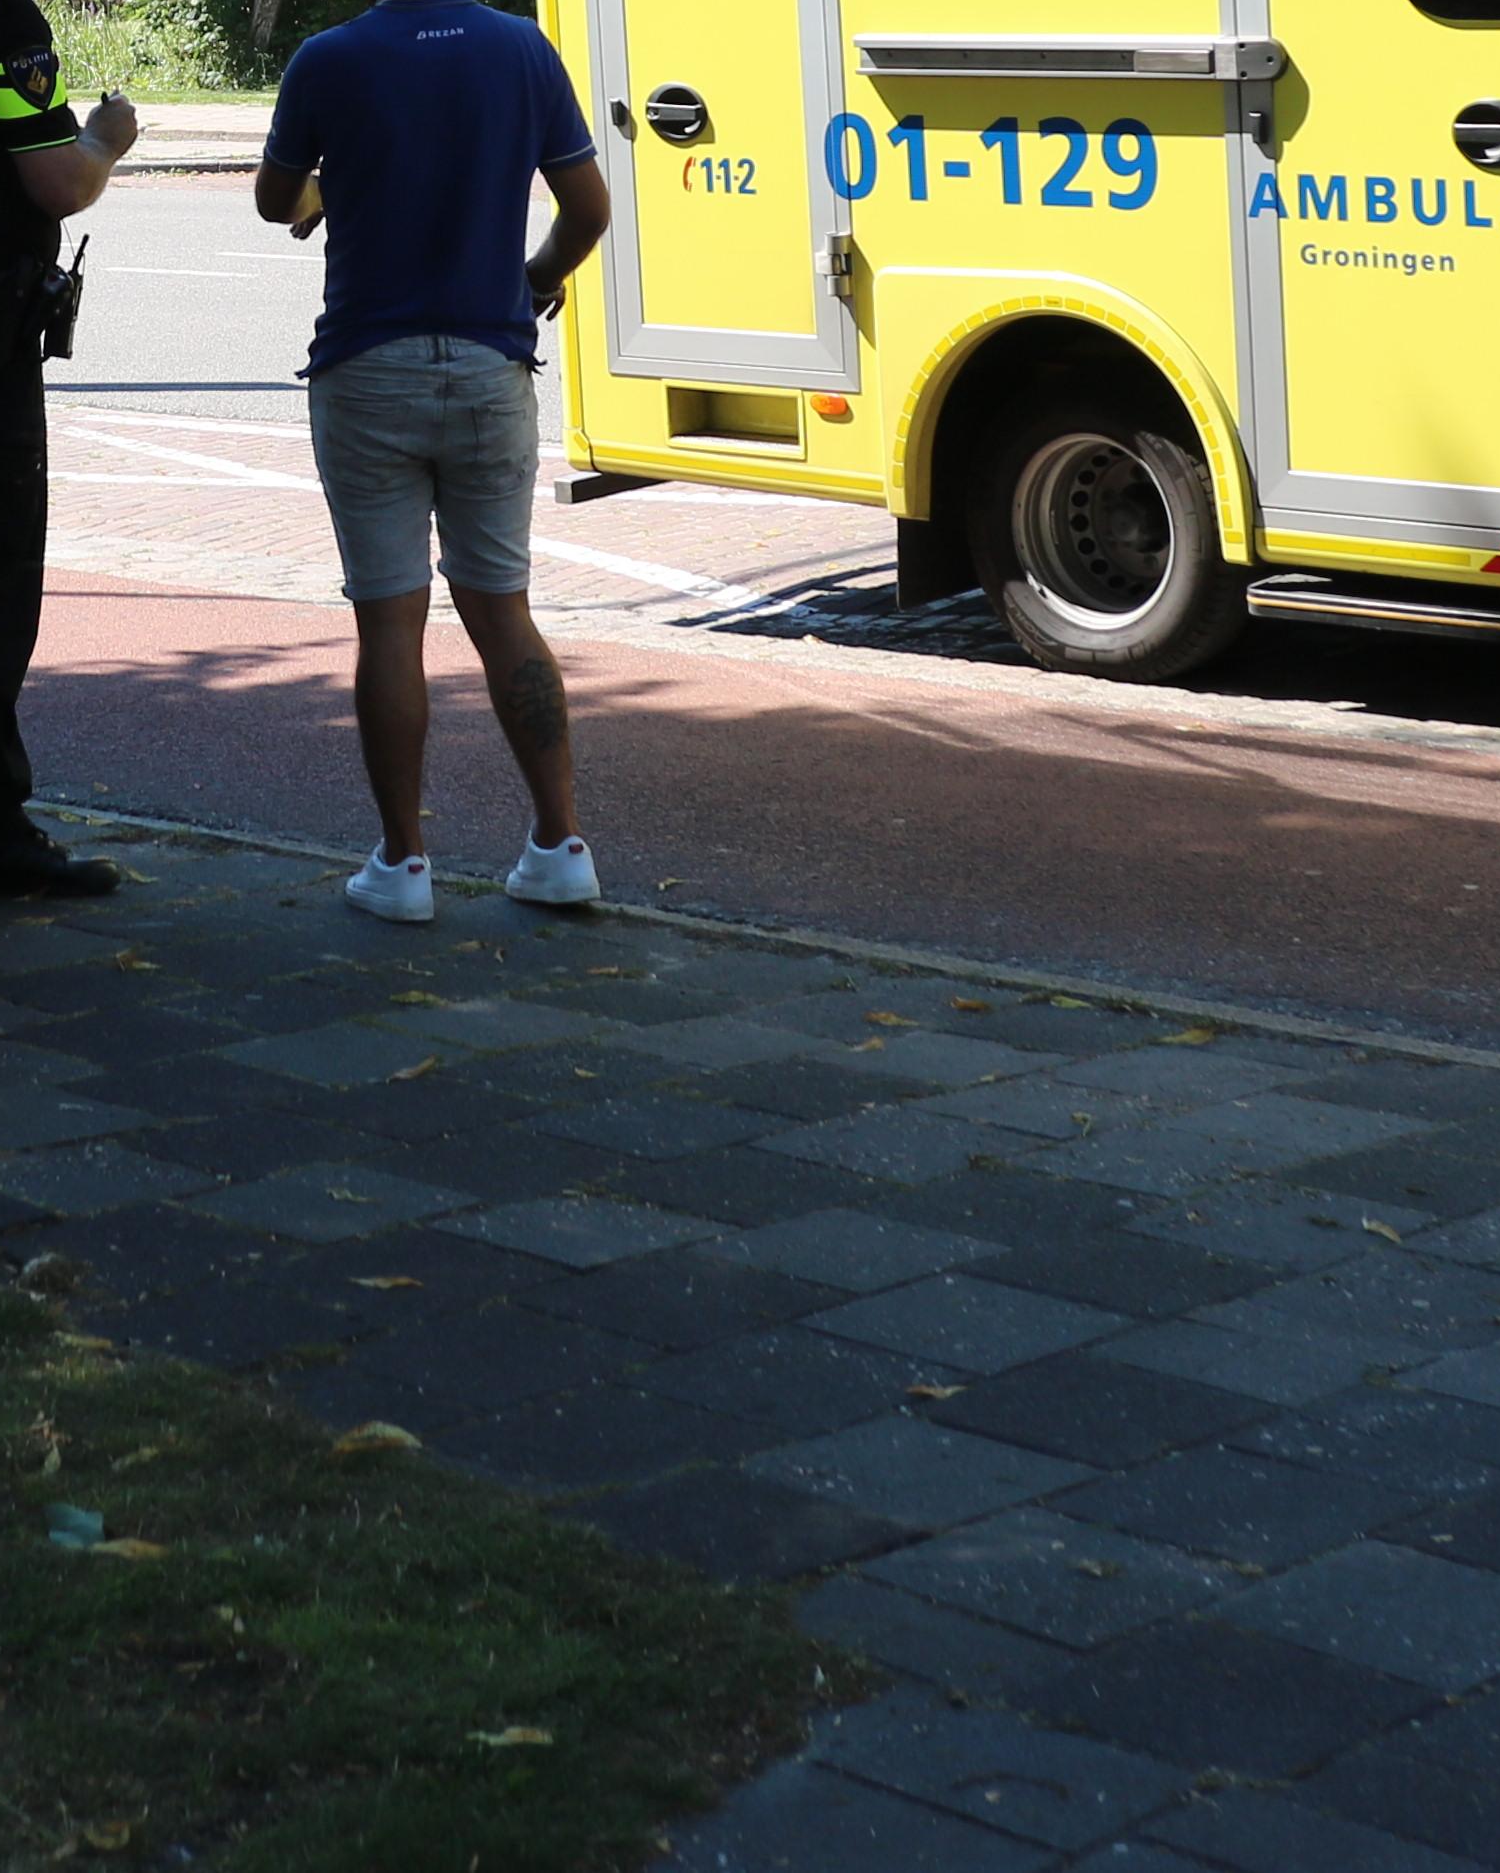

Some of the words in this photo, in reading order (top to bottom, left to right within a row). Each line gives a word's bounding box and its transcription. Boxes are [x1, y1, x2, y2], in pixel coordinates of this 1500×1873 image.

[417, 27, 464, 40] BREZAN
[12, 51, 50, 69] POLITIE
[824, 112, 1159, 211] 01-129
[1299, 244, 1456, 276] Groningen
